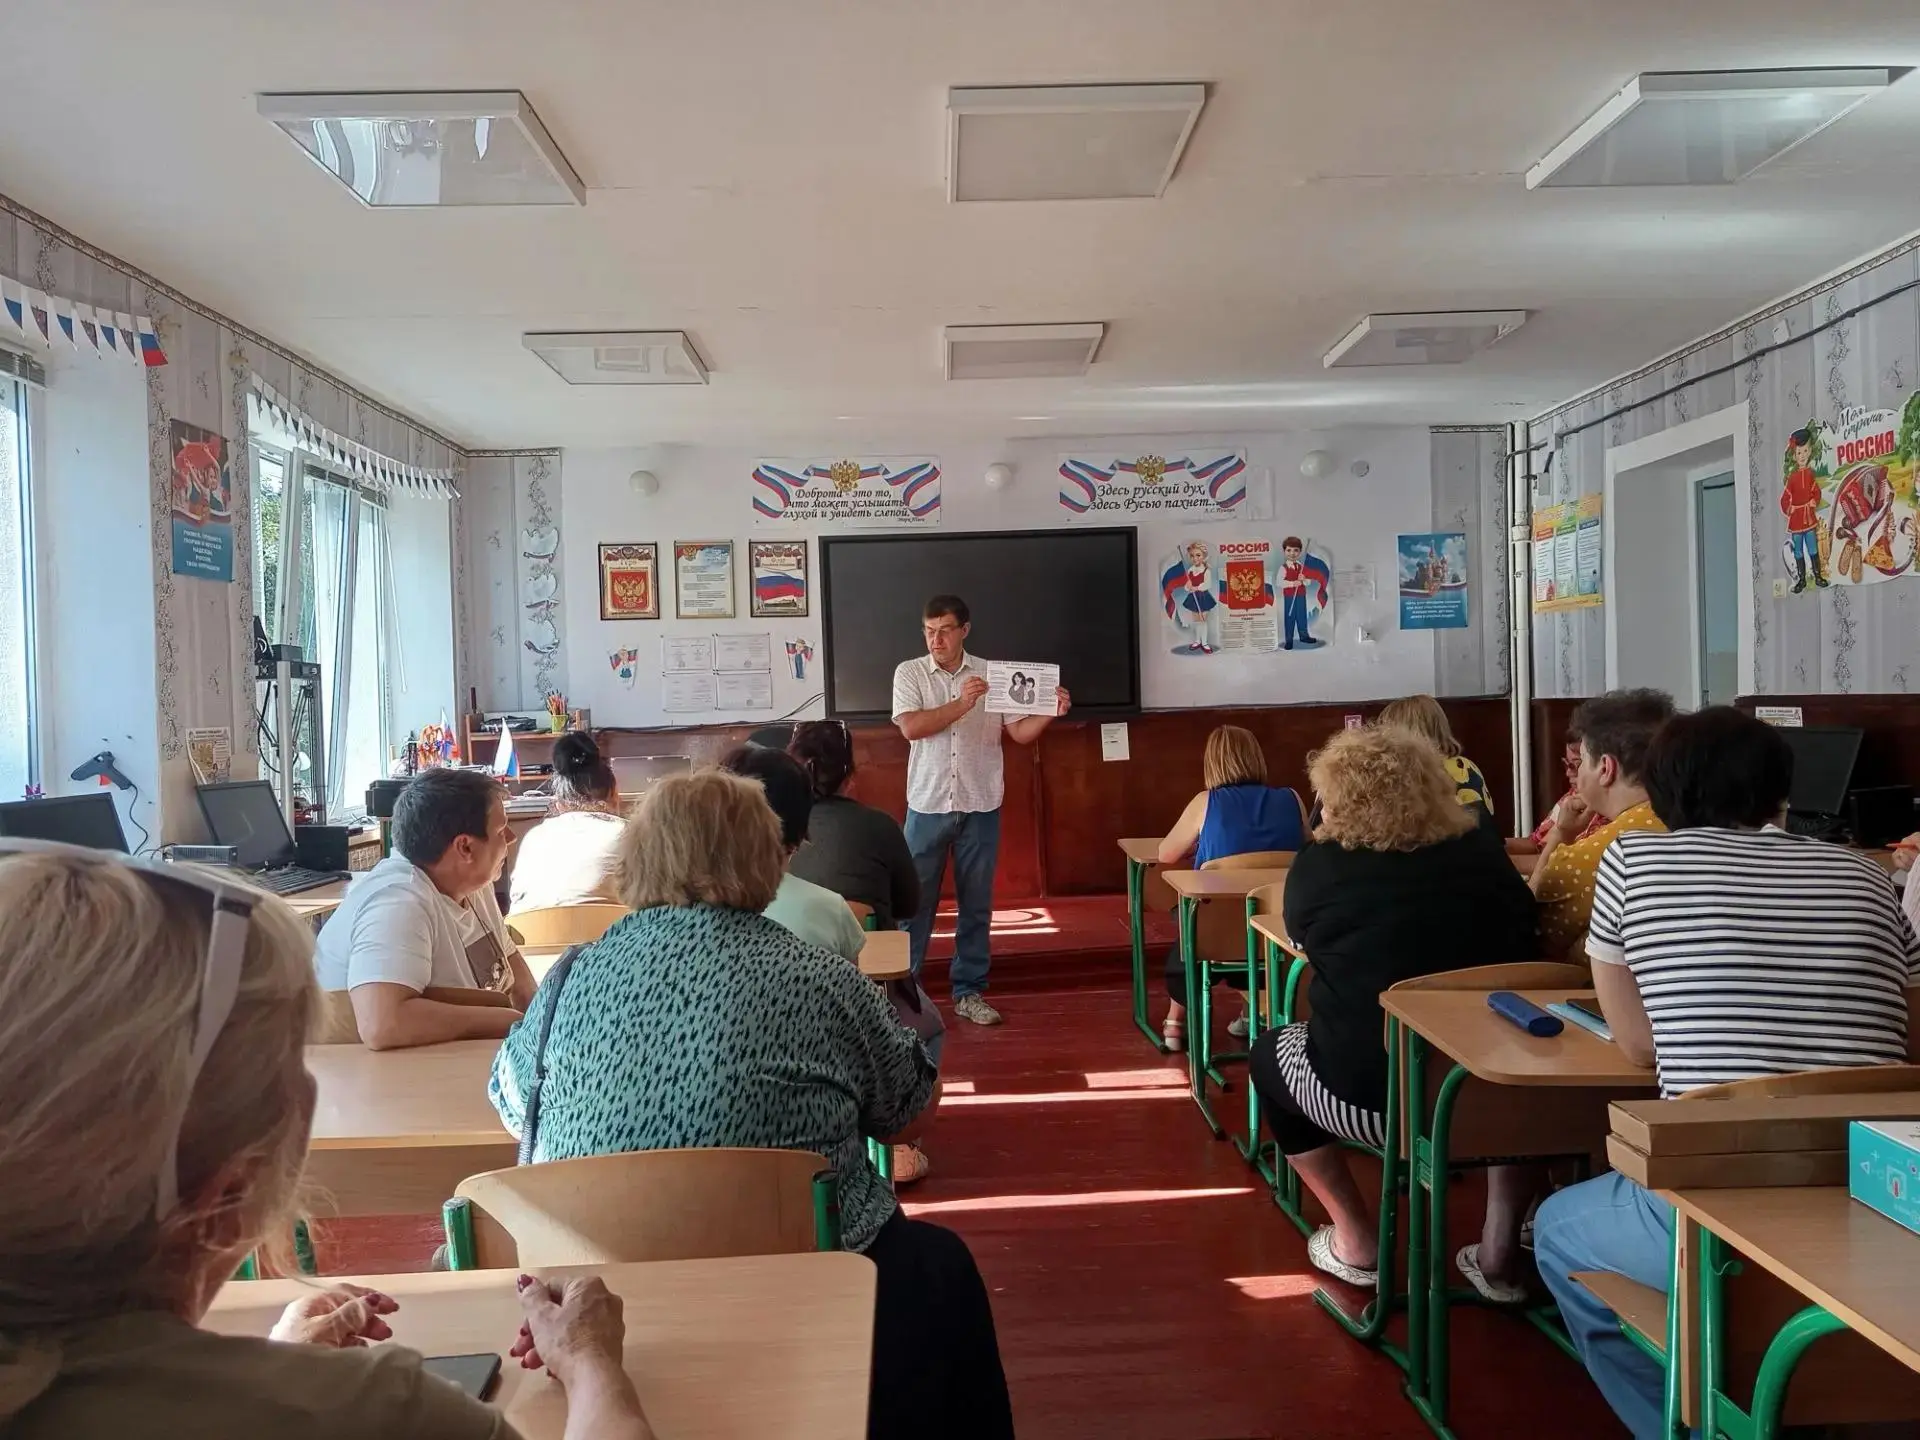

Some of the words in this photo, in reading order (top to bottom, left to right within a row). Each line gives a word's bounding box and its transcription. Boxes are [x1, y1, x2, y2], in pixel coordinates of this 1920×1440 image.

[1843, 413, 1884, 440] страна
[1837, 430, 1895, 467] РОССИЯ
[794, 487, 843, 502] Доброта
[852, 489, 873, 499] это
[875, 489, 892, 500] то,
[1097, 483, 1130, 498] Здесь
[1133, 483, 1180, 499] русский
[1183, 481, 1206, 498] дух,
[788, 500, 810, 509] что
[811, 499, 849, 511] может
[851, 499, 906, 511] услышать
[1091, 497, 1121, 511] здесь
[1124, 498, 1162, 513] Русью
[782, 508, 819, 522] глухой
[821, 510, 828, 518] и
[829, 507, 872, 521] увидеть
[874, 508, 911, 518] слепой.
[1218, 542, 1270, 555] РОССИЯ
